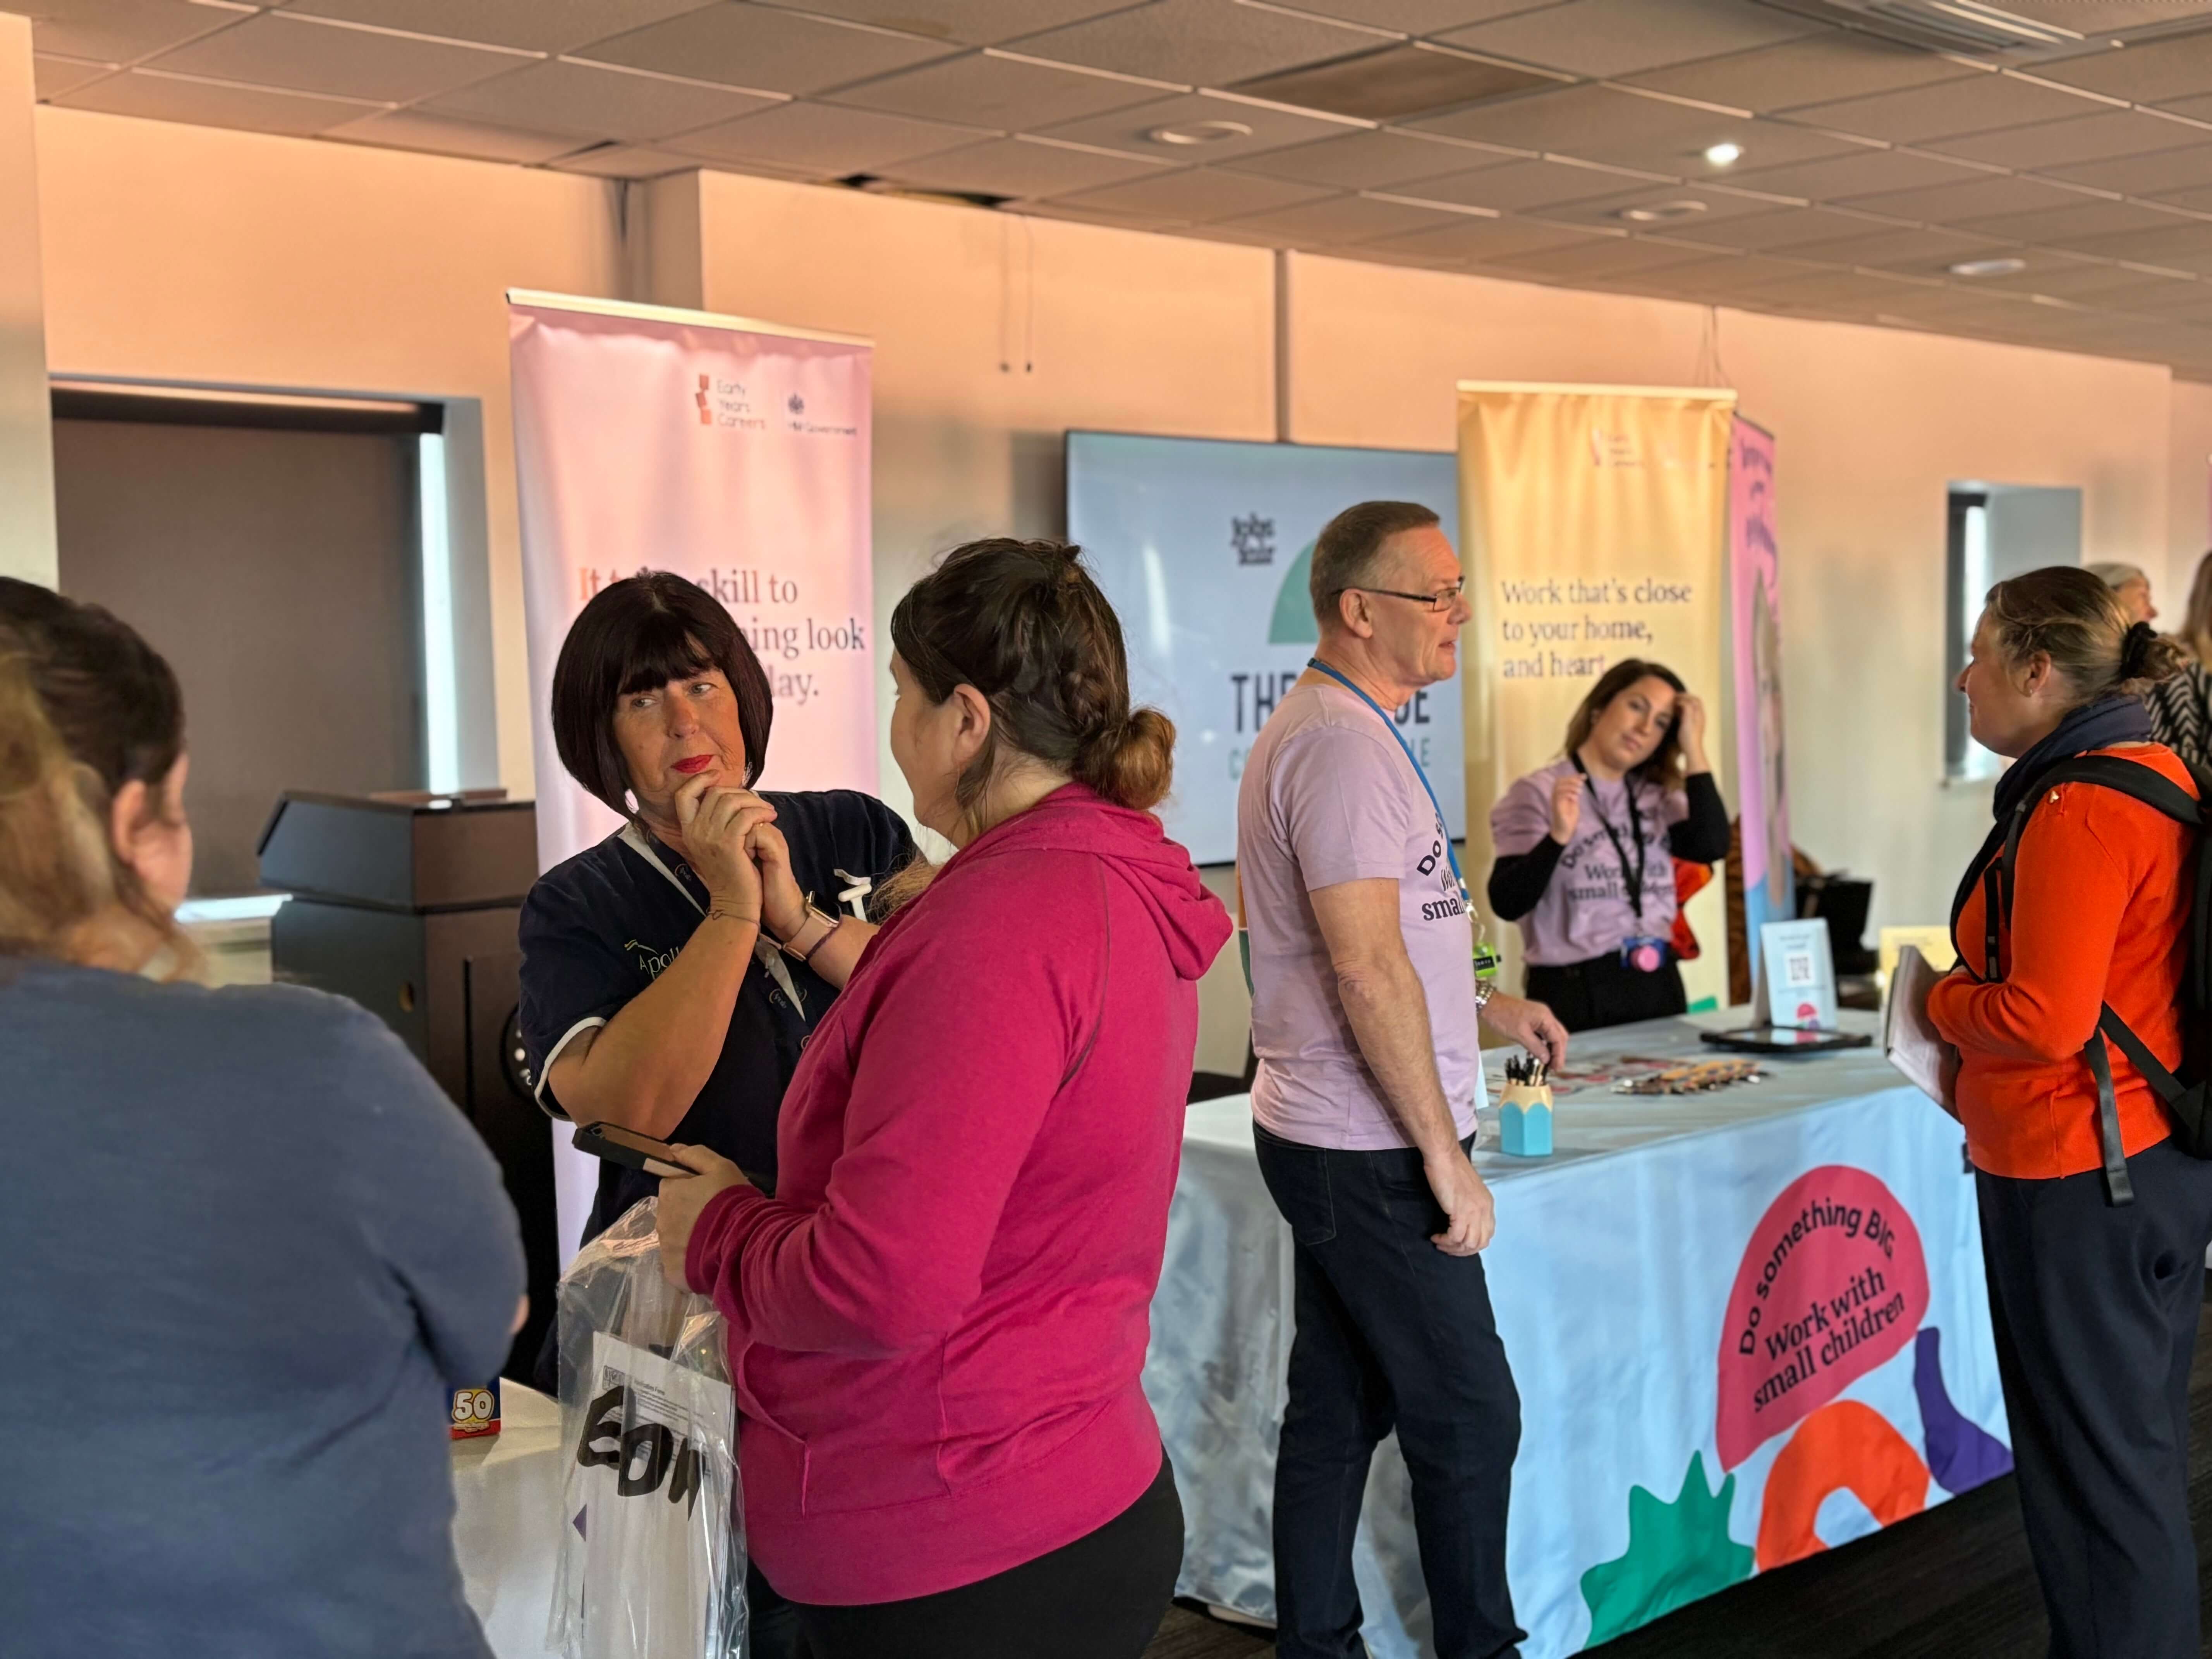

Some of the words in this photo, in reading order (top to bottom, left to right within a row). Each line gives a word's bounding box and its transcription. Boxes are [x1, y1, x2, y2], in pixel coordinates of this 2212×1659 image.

[769, 574, 797, 603] to
[1502, 580, 1561, 605] Work
[1635, 579, 1692, 604] close
[807, 618, 864, 649] look
[1503, 620, 1523, 641] to
[1530, 622, 1579, 647] your
[1585, 614, 1653, 644] home,
[1504, 652, 1542, 678] and
[768, 664, 818, 706] lay.
[1417, 840, 1441, 876] Do
[1584, 864, 1620, 879] Wor
[1738, 1306, 1762, 1355] Do
[1756, 1197, 1862, 1299] something
[1864, 1209, 1895, 1261] BIG
[1765, 1302, 1831, 1361] Work
[1830, 1266, 1886, 1319] with
[1753, 1345, 1817, 1413] small
[1821, 1291, 1905, 1366] children
[452, 1389, 494, 1421] 50
